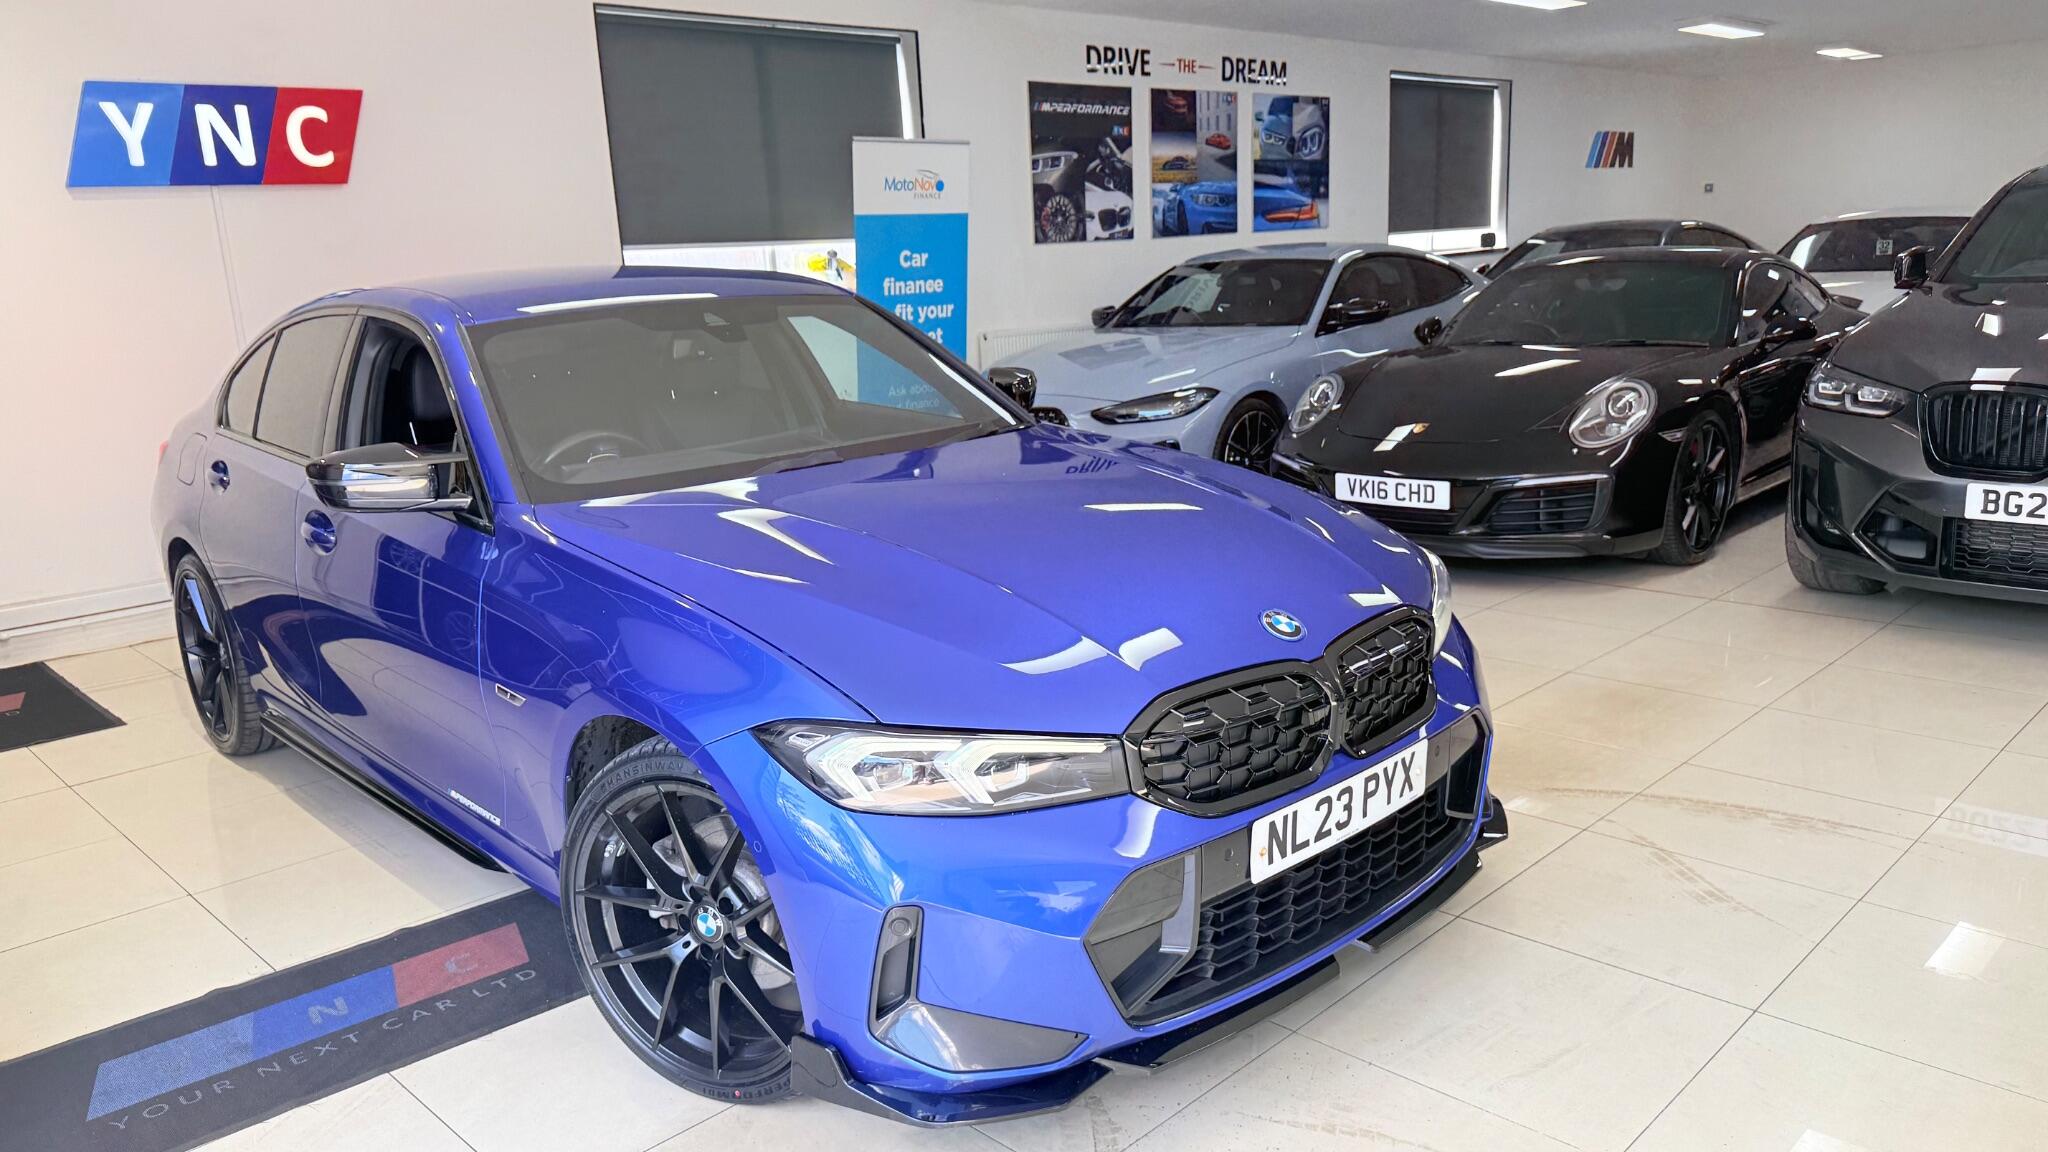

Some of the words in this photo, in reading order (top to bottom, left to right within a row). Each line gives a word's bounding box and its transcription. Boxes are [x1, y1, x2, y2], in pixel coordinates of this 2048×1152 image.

[1086, 44, 1151, 77] DRIVE
[1177, 58, 1198, 74] THE
[1222, 56, 1287, 87] DREAM
[98, 101, 335, 168] YNC
[899, 250, 929, 269] Car
[883, 277, 944, 296] finance
[895, 304, 914, 321] fit
[917, 304, 954, 324] your
[888, 384, 906, 397] Ask
[910, 382, 935, 395] abou
[1347, 477, 1389, 500] VK16
[1395, 482, 1436, 504] CHD
[1981, 489, 2047, 519] BG2
[1267, 785, 1354, 866] NL23
[1362, 752, 1416, 819] PYX
[109, 1080, 235, 1129] YOUR
[257, 1031, 360, 1077] NEXT
[382, 999, 457, 1030] CAR
[472, 970, 536, 998] LTD
